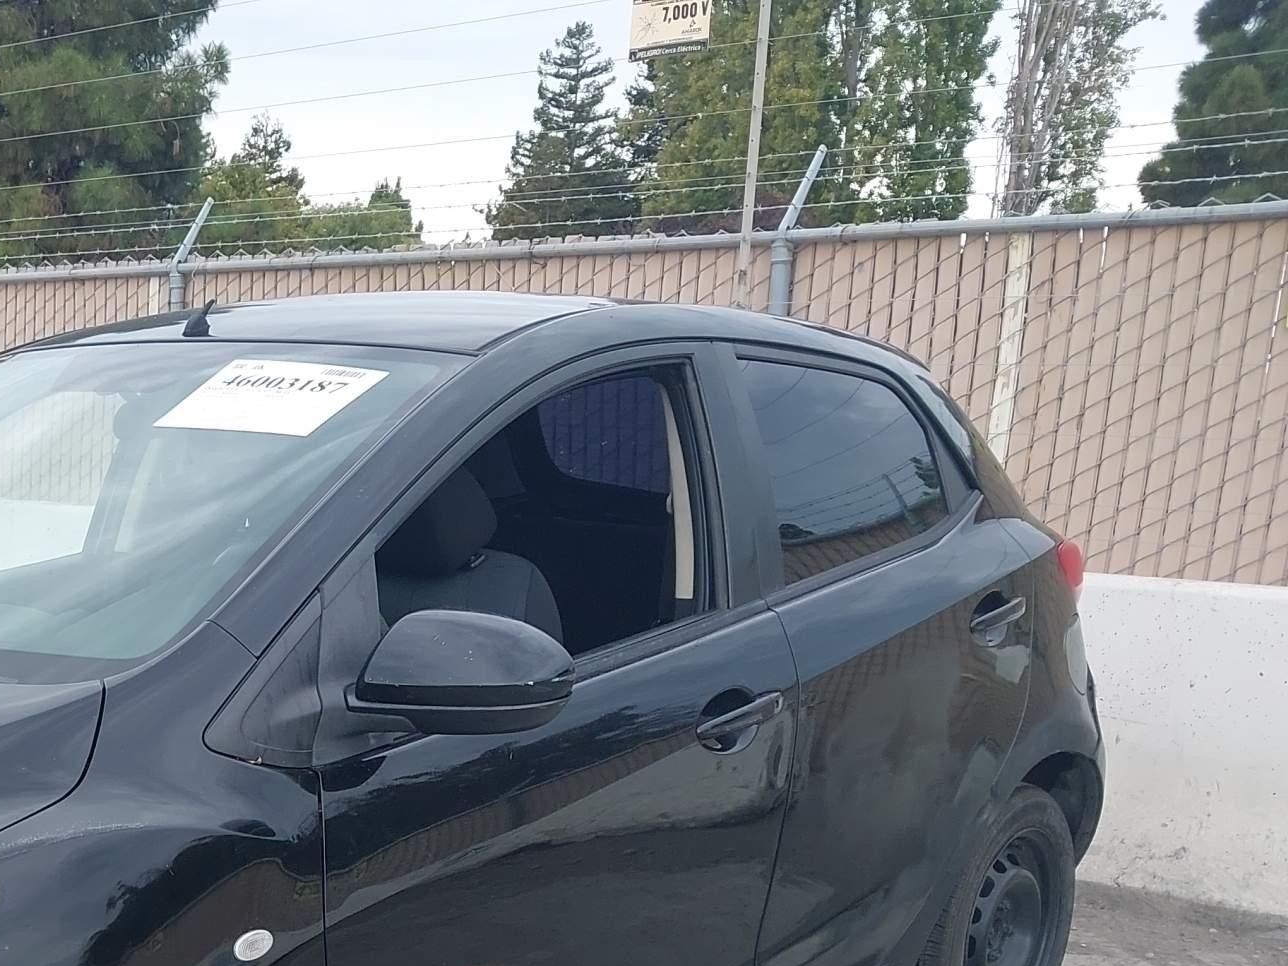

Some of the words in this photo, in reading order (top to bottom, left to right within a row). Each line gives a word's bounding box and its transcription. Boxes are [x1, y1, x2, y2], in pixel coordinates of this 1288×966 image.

[663, 2, 697, 23] 7,000
[702, 0, 709, 16] V
[223, 374, 350, 394] 46003187
